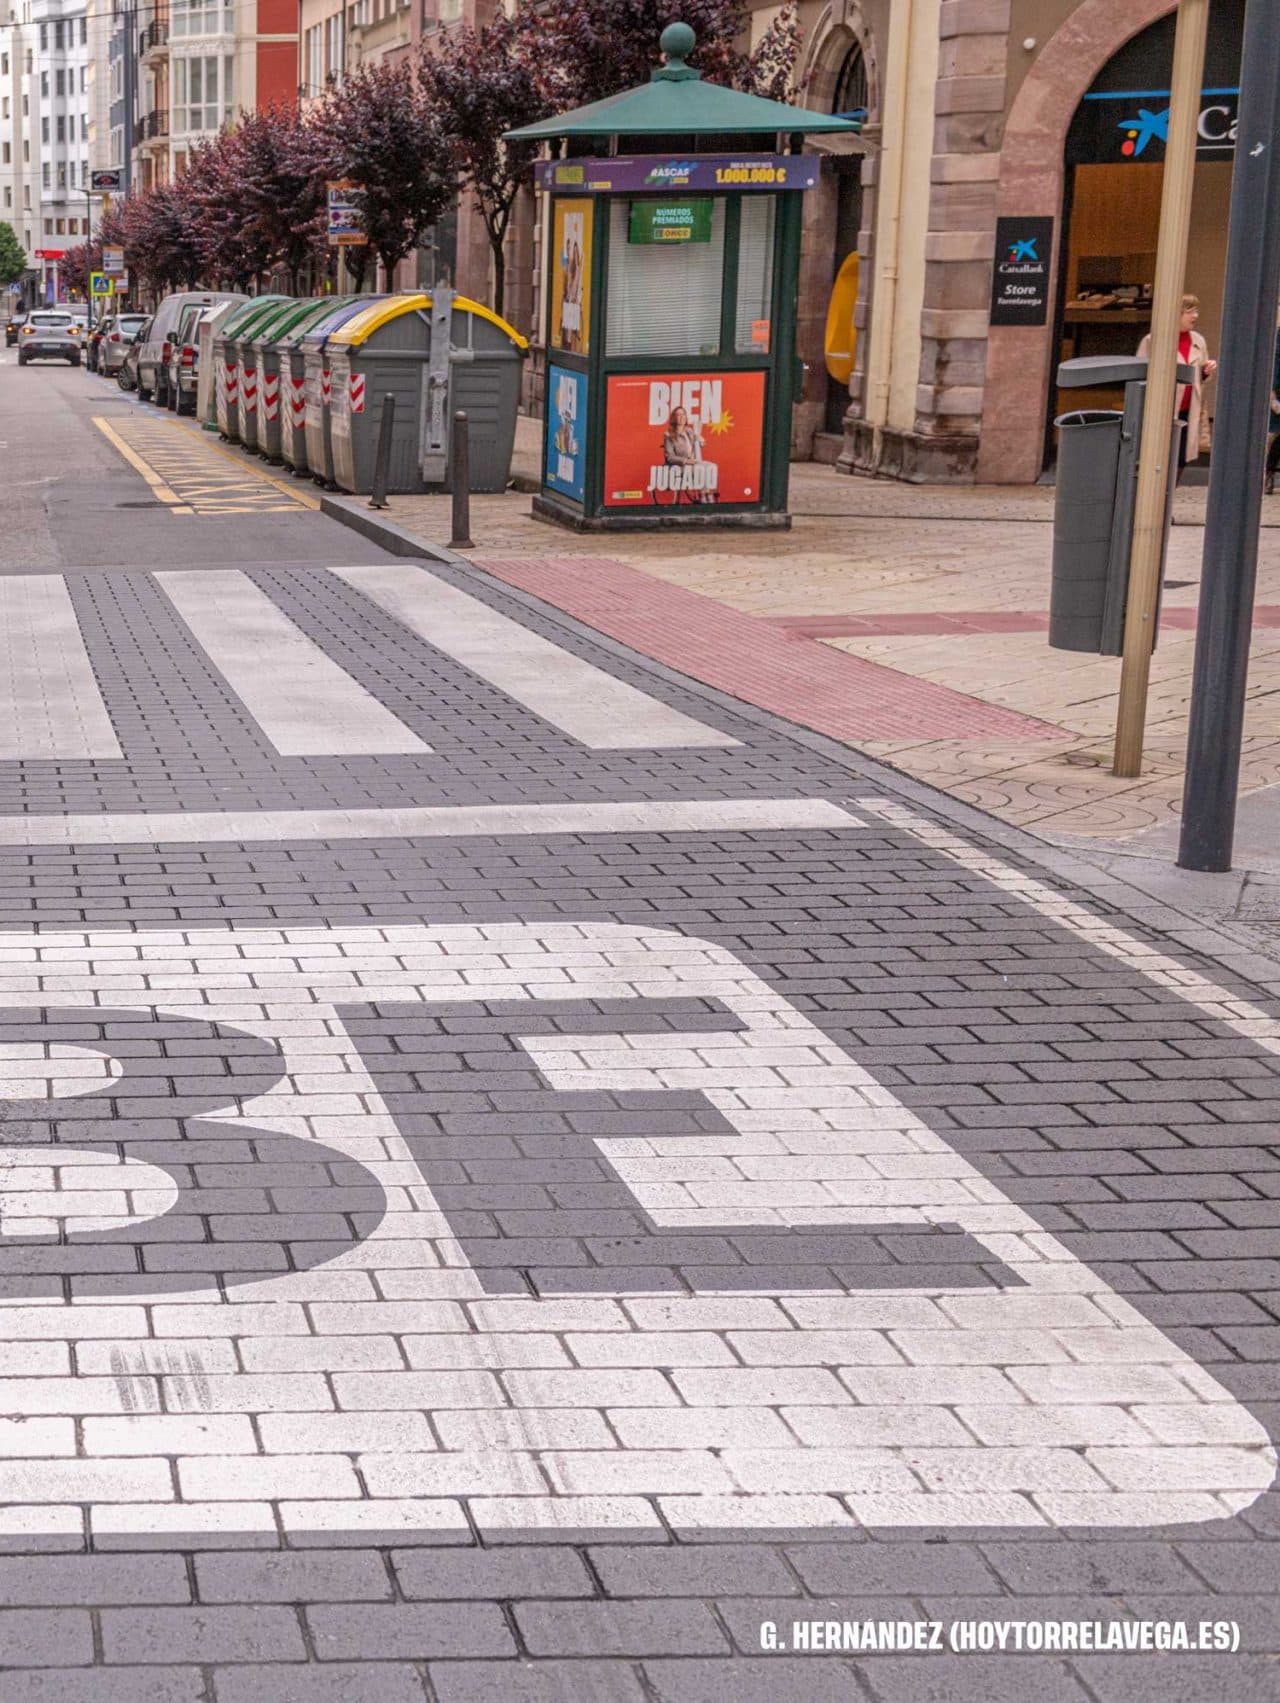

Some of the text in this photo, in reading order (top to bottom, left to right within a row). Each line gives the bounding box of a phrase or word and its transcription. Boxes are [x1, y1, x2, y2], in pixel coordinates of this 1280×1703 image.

[715, 167, 787, 183] 1.000.000 €
[652, 215, 694, 225] PREMIADOS
[999, 264, 1043, 273] CaixaBank
[1003, 284, 1036, 295] Store
[997, 297, 1042, 307] Torrelavega
[648, 380, 722, 426] BIEN
[647, 462, 718, 492] JUGADO
